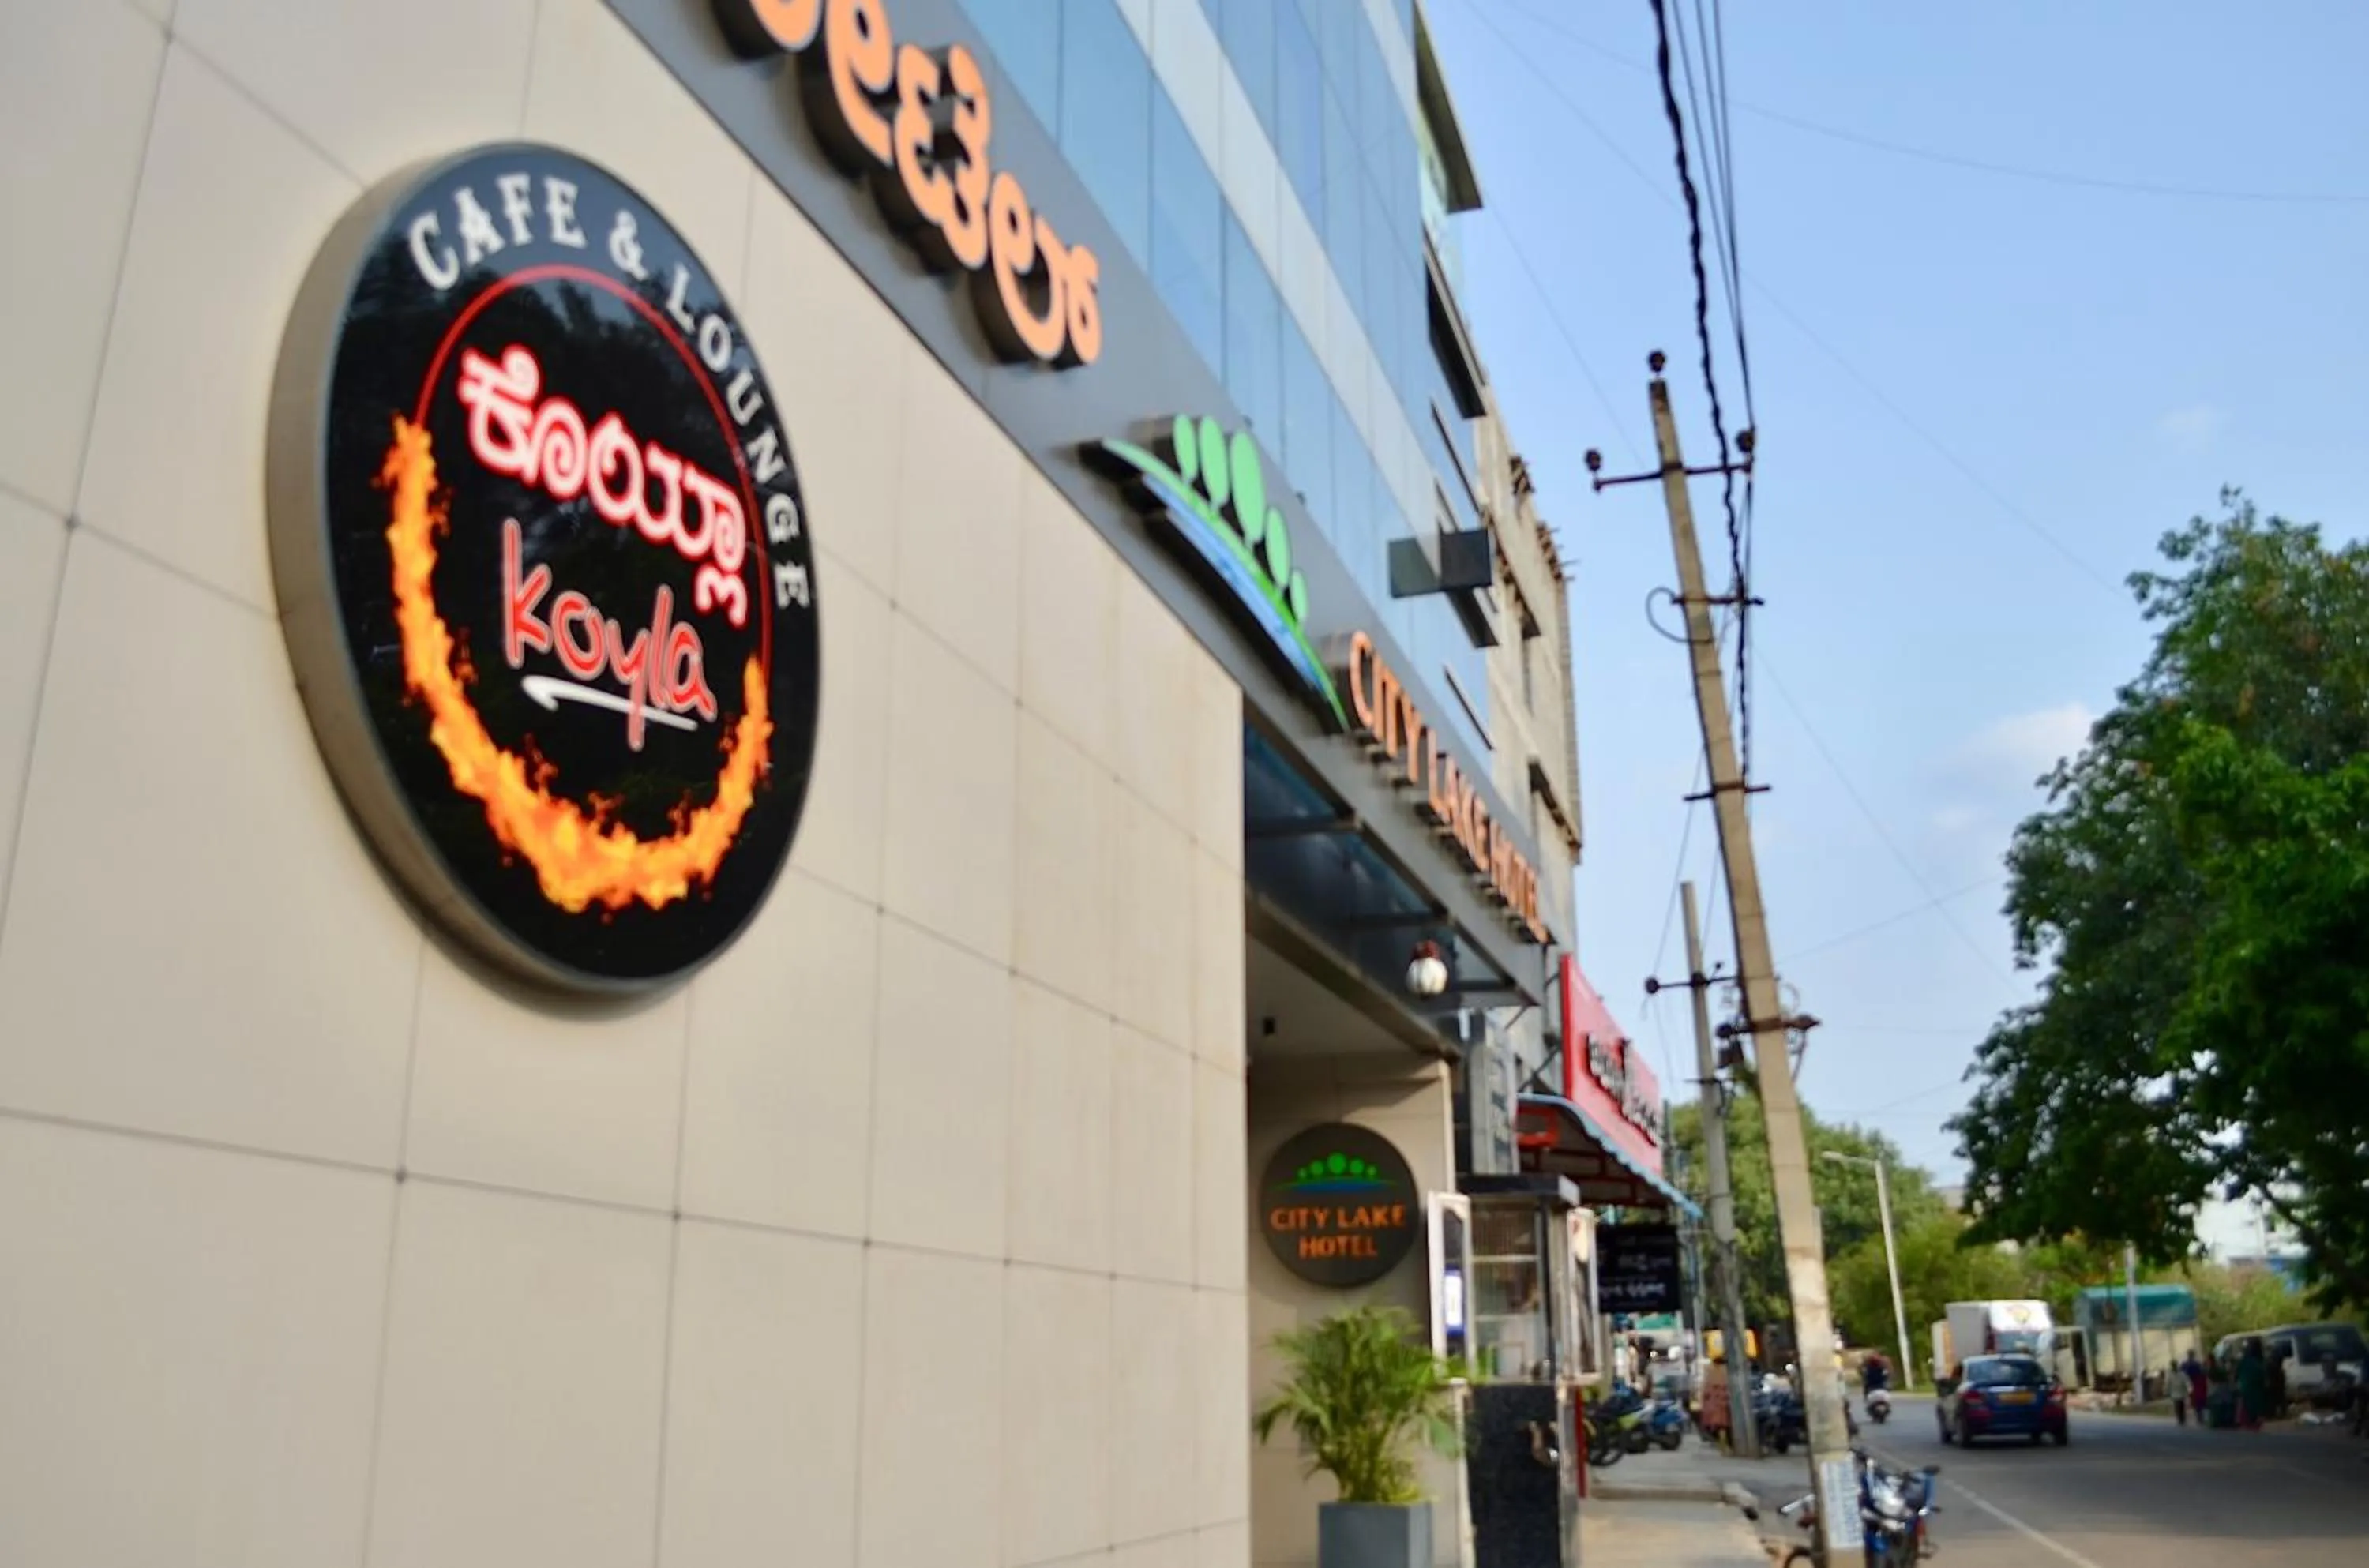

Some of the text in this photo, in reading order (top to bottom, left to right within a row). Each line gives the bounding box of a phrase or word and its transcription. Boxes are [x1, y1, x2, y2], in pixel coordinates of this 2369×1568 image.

[410, 173, 810, 610] CAFE & LOUNGE
[1349, 630, 1421, 786] CITY
[1270, 1207, 1330, 1229] CITY
[1299, 1235, 1378, 1259] HOTEL
